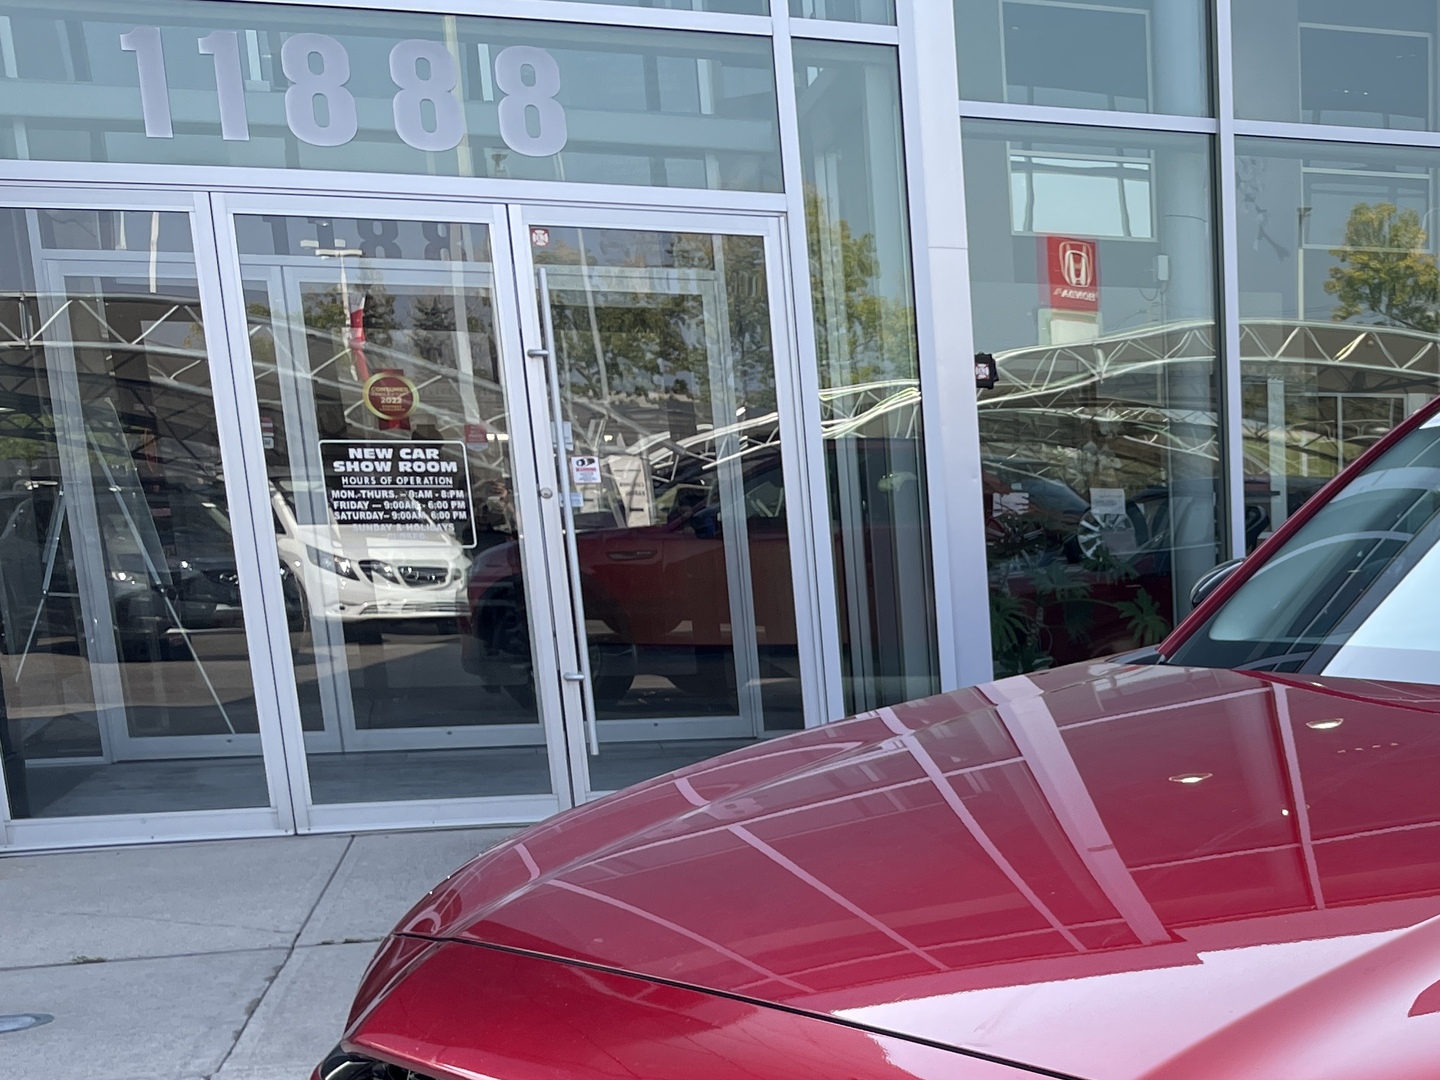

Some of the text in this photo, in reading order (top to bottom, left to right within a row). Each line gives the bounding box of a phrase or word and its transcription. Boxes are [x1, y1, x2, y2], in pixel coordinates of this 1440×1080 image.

[119, 26, 568, 157] 11888
[380, 396, 402, 404] 2022
[348, 448, 440, 459] NEW CAR
[333, 461, 458, 473] SHOW ROOM
[341, 476, 453, 485] HOURS OF OPERATION
[332, 501, 370, 510] FRIDAY
[383, 501, 421, 510] 9:00AM
[427, 501, 448, 510] 6:00
[451, 501, 466, 509] PM
[430, 511, 451, 520] 6:00
[452, 511, 468, 520] PM
[352, 523, 393, 532] SUNDAY
[405, 523, 455, 532] HOLIDAYS
